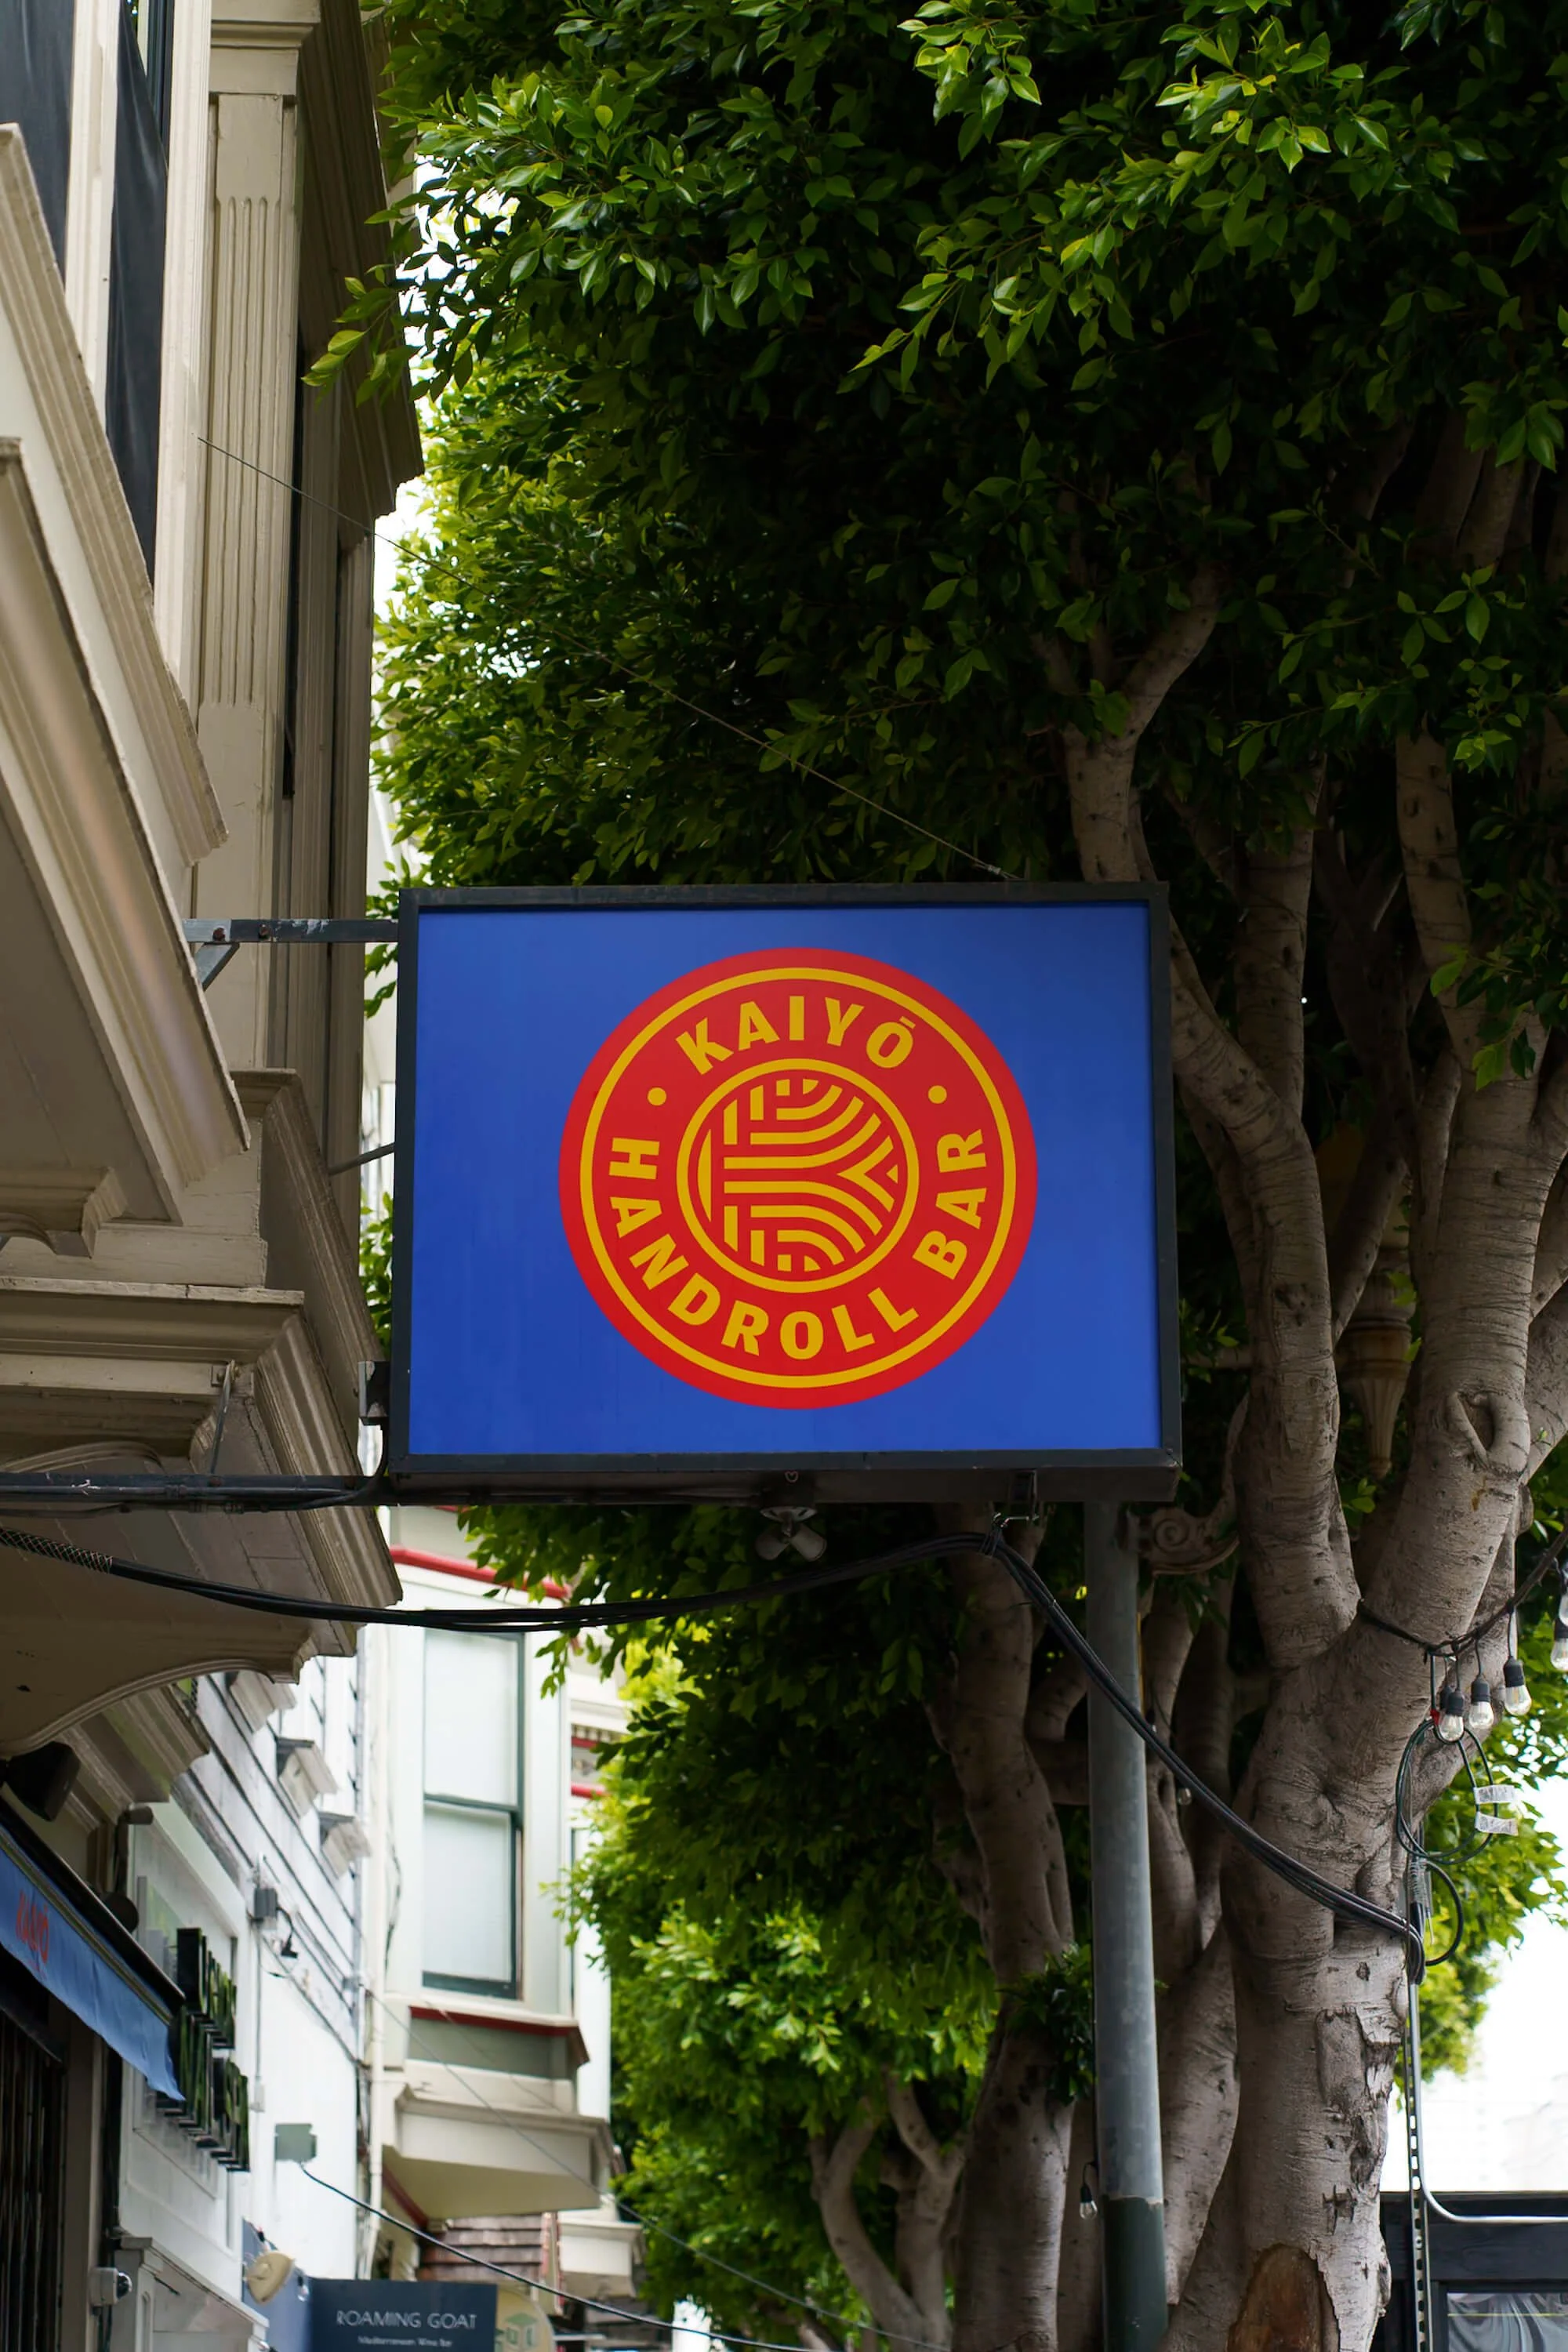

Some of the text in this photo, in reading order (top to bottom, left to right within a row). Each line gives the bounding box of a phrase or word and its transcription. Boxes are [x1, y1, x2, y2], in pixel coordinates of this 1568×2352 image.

[676, 996, 916, 1075] KAIYŌ
[608, 1129, 986, 1359] HANDROLL BAR
[336, 2310, 477, 2329] ROAMING GOAT
